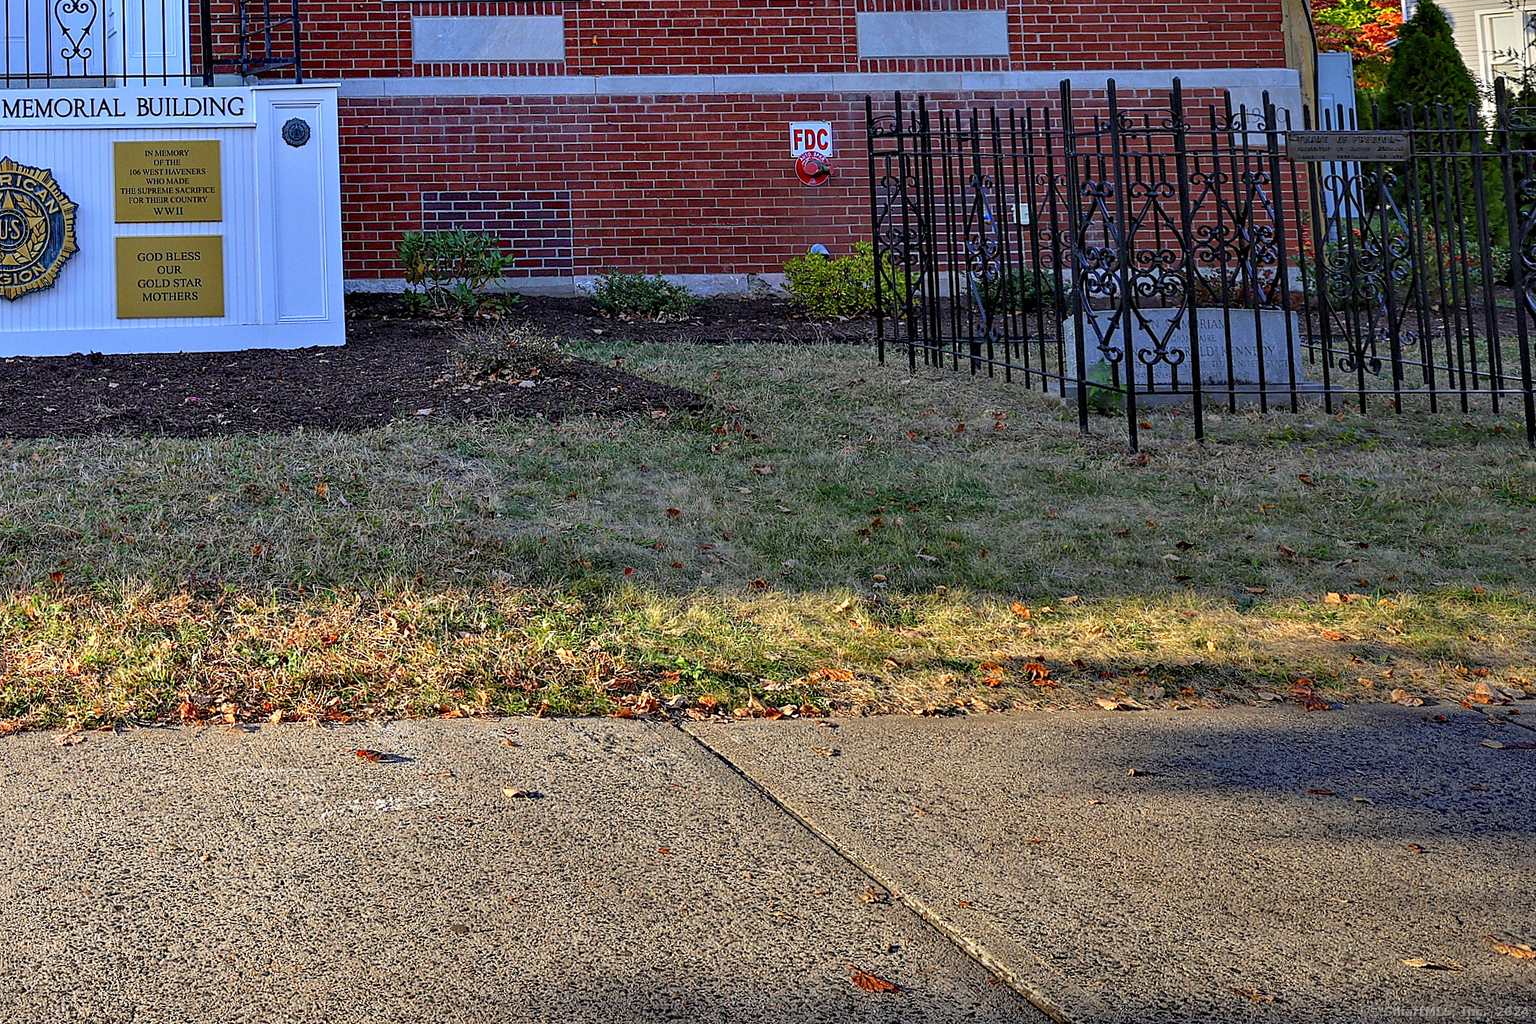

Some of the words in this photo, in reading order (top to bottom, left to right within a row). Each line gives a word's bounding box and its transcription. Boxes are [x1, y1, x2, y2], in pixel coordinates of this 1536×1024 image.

[2, 98, 125, 118] MEMORIAL
[137, 97, 244, 117] BUILDING
[1245, 107, 1287, 123] 190
[794, 128, 828, 150] FDC
[137, 252, 163, 261] GOD
[166, 252, 201, 261] BLESS
[157, 266, 182, 274] OUR
[138, 279, 170, 288] GOLD
[173, 278, 202, 287] STAR
[142, 292, 198, 302] MOTHERS
